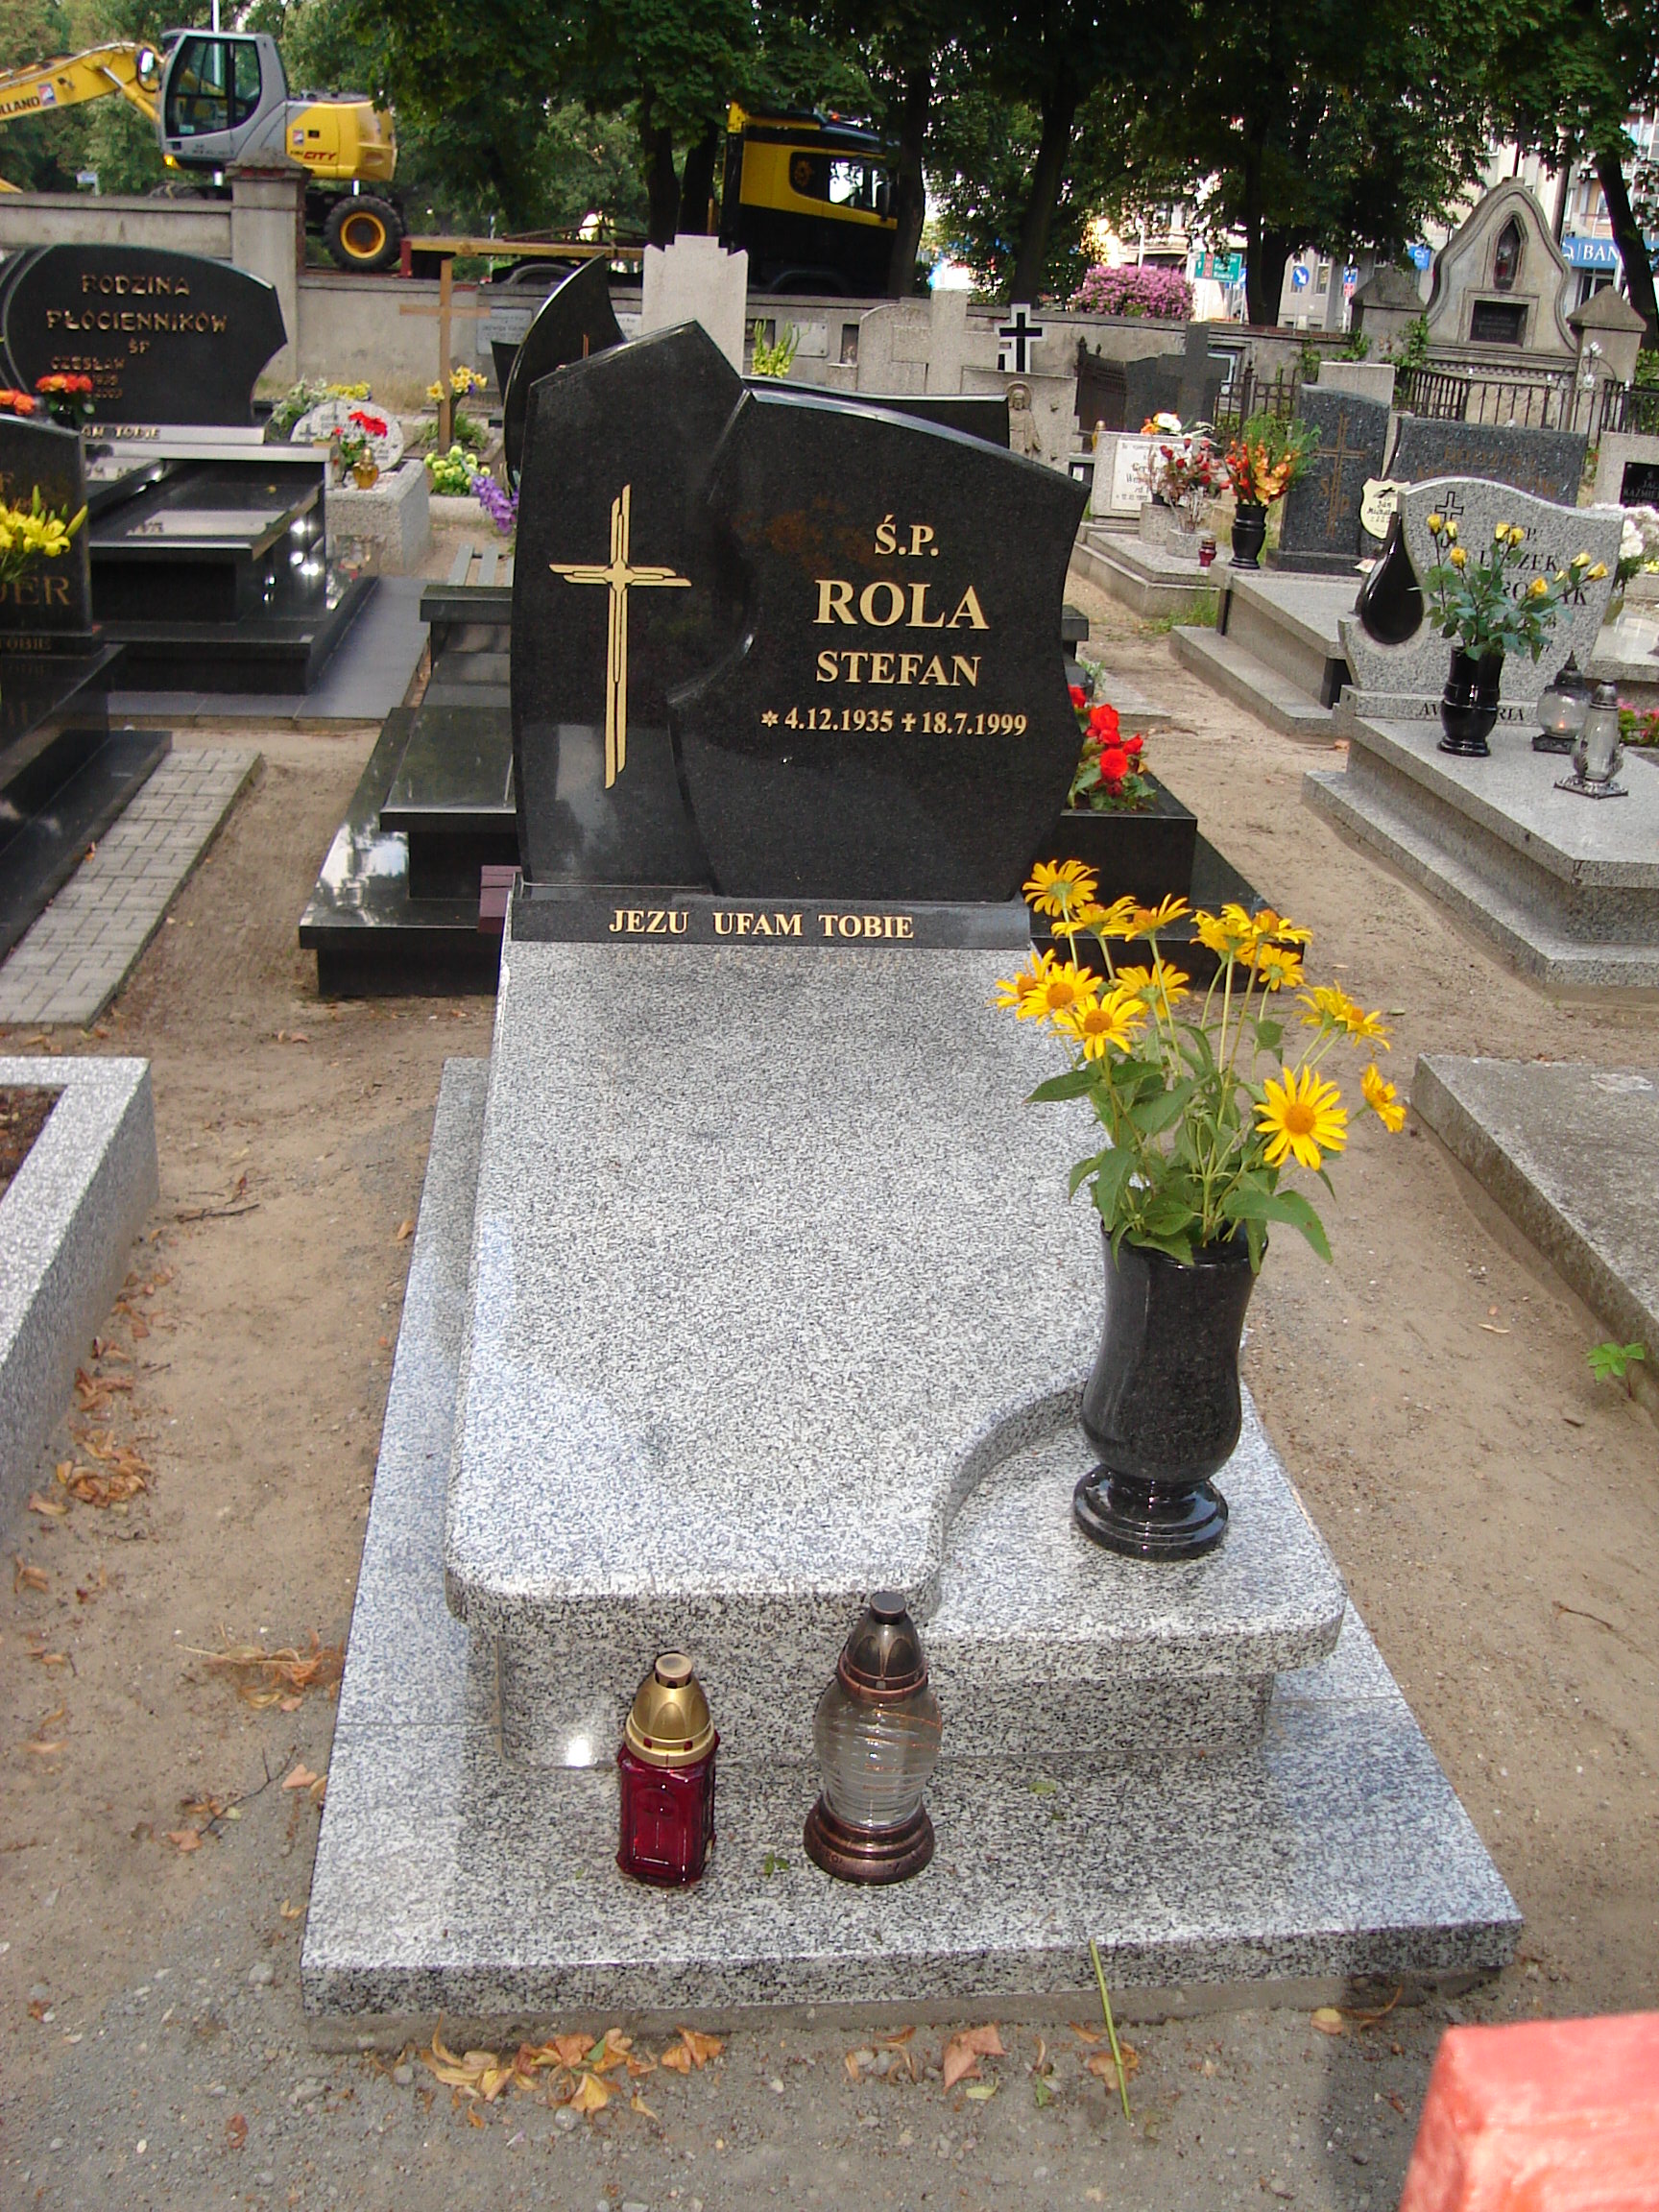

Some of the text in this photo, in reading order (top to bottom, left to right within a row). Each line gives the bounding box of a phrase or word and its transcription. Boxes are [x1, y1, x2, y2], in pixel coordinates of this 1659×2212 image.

[302, 151, 337, 161] CITY
[82, 273, 190, 296] RODZINA
[874, 514, 939, 557] Ś.P.
[1479, 549, 1560, 572] LZEK
[0, 576, 70, 607] ER
[812, 579, 990, 630] ROLA
[816, 649, 981, 687] STEFAN
[783, 706, 1028, 736] 4.12.1935 18.7.1999
[609, 909, 914, 940] JEZU UFAM TOBIE
